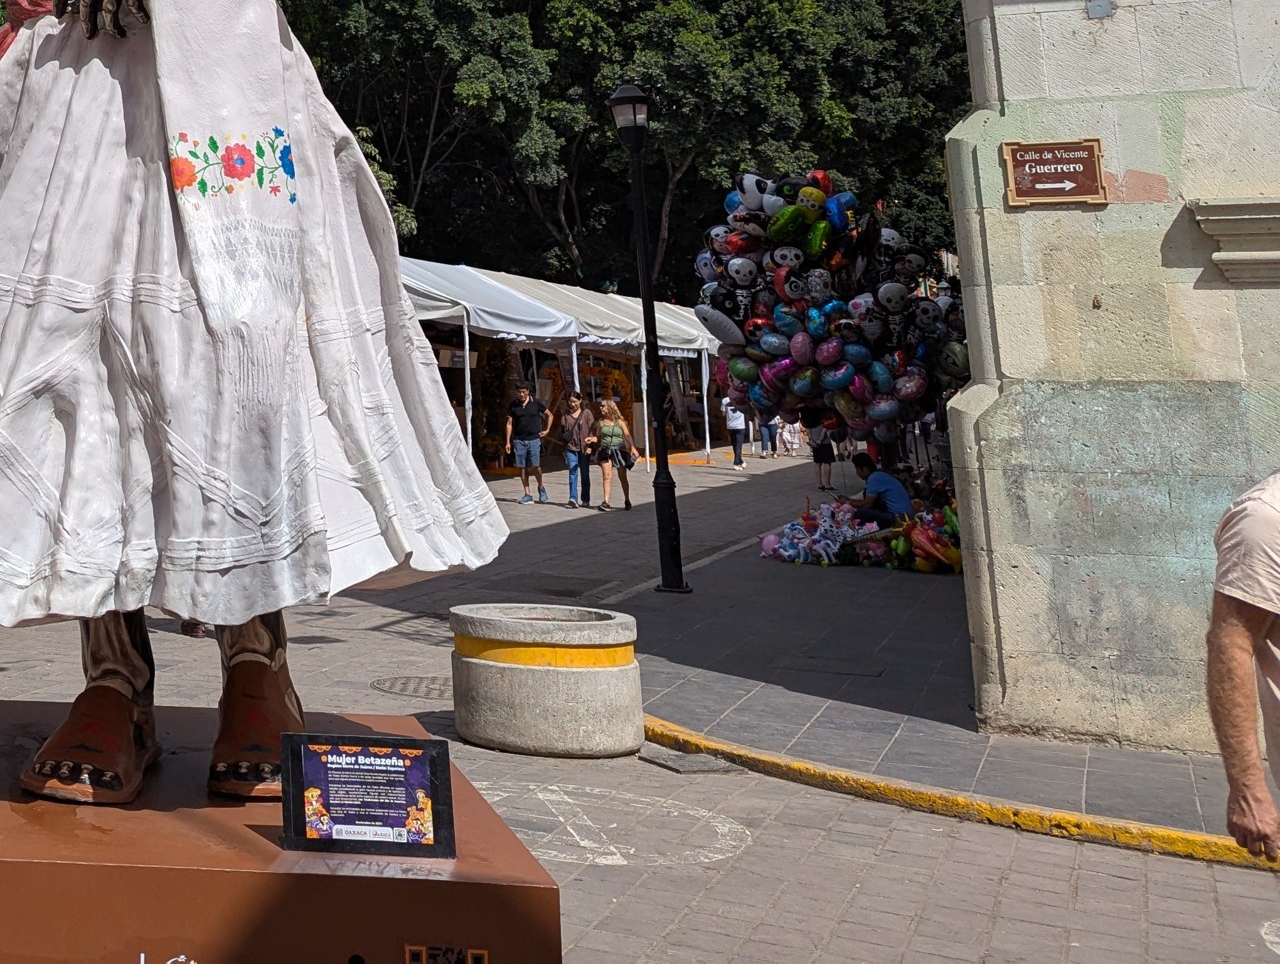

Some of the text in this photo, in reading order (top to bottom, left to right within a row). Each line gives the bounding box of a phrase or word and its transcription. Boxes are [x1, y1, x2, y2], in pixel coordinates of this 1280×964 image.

[1017, 149, 1089, 160] Calle de Vicente
[1025, 162, 1083, 174] Guerrero
[327, 754, 404, 767] Mujer Betazeña
